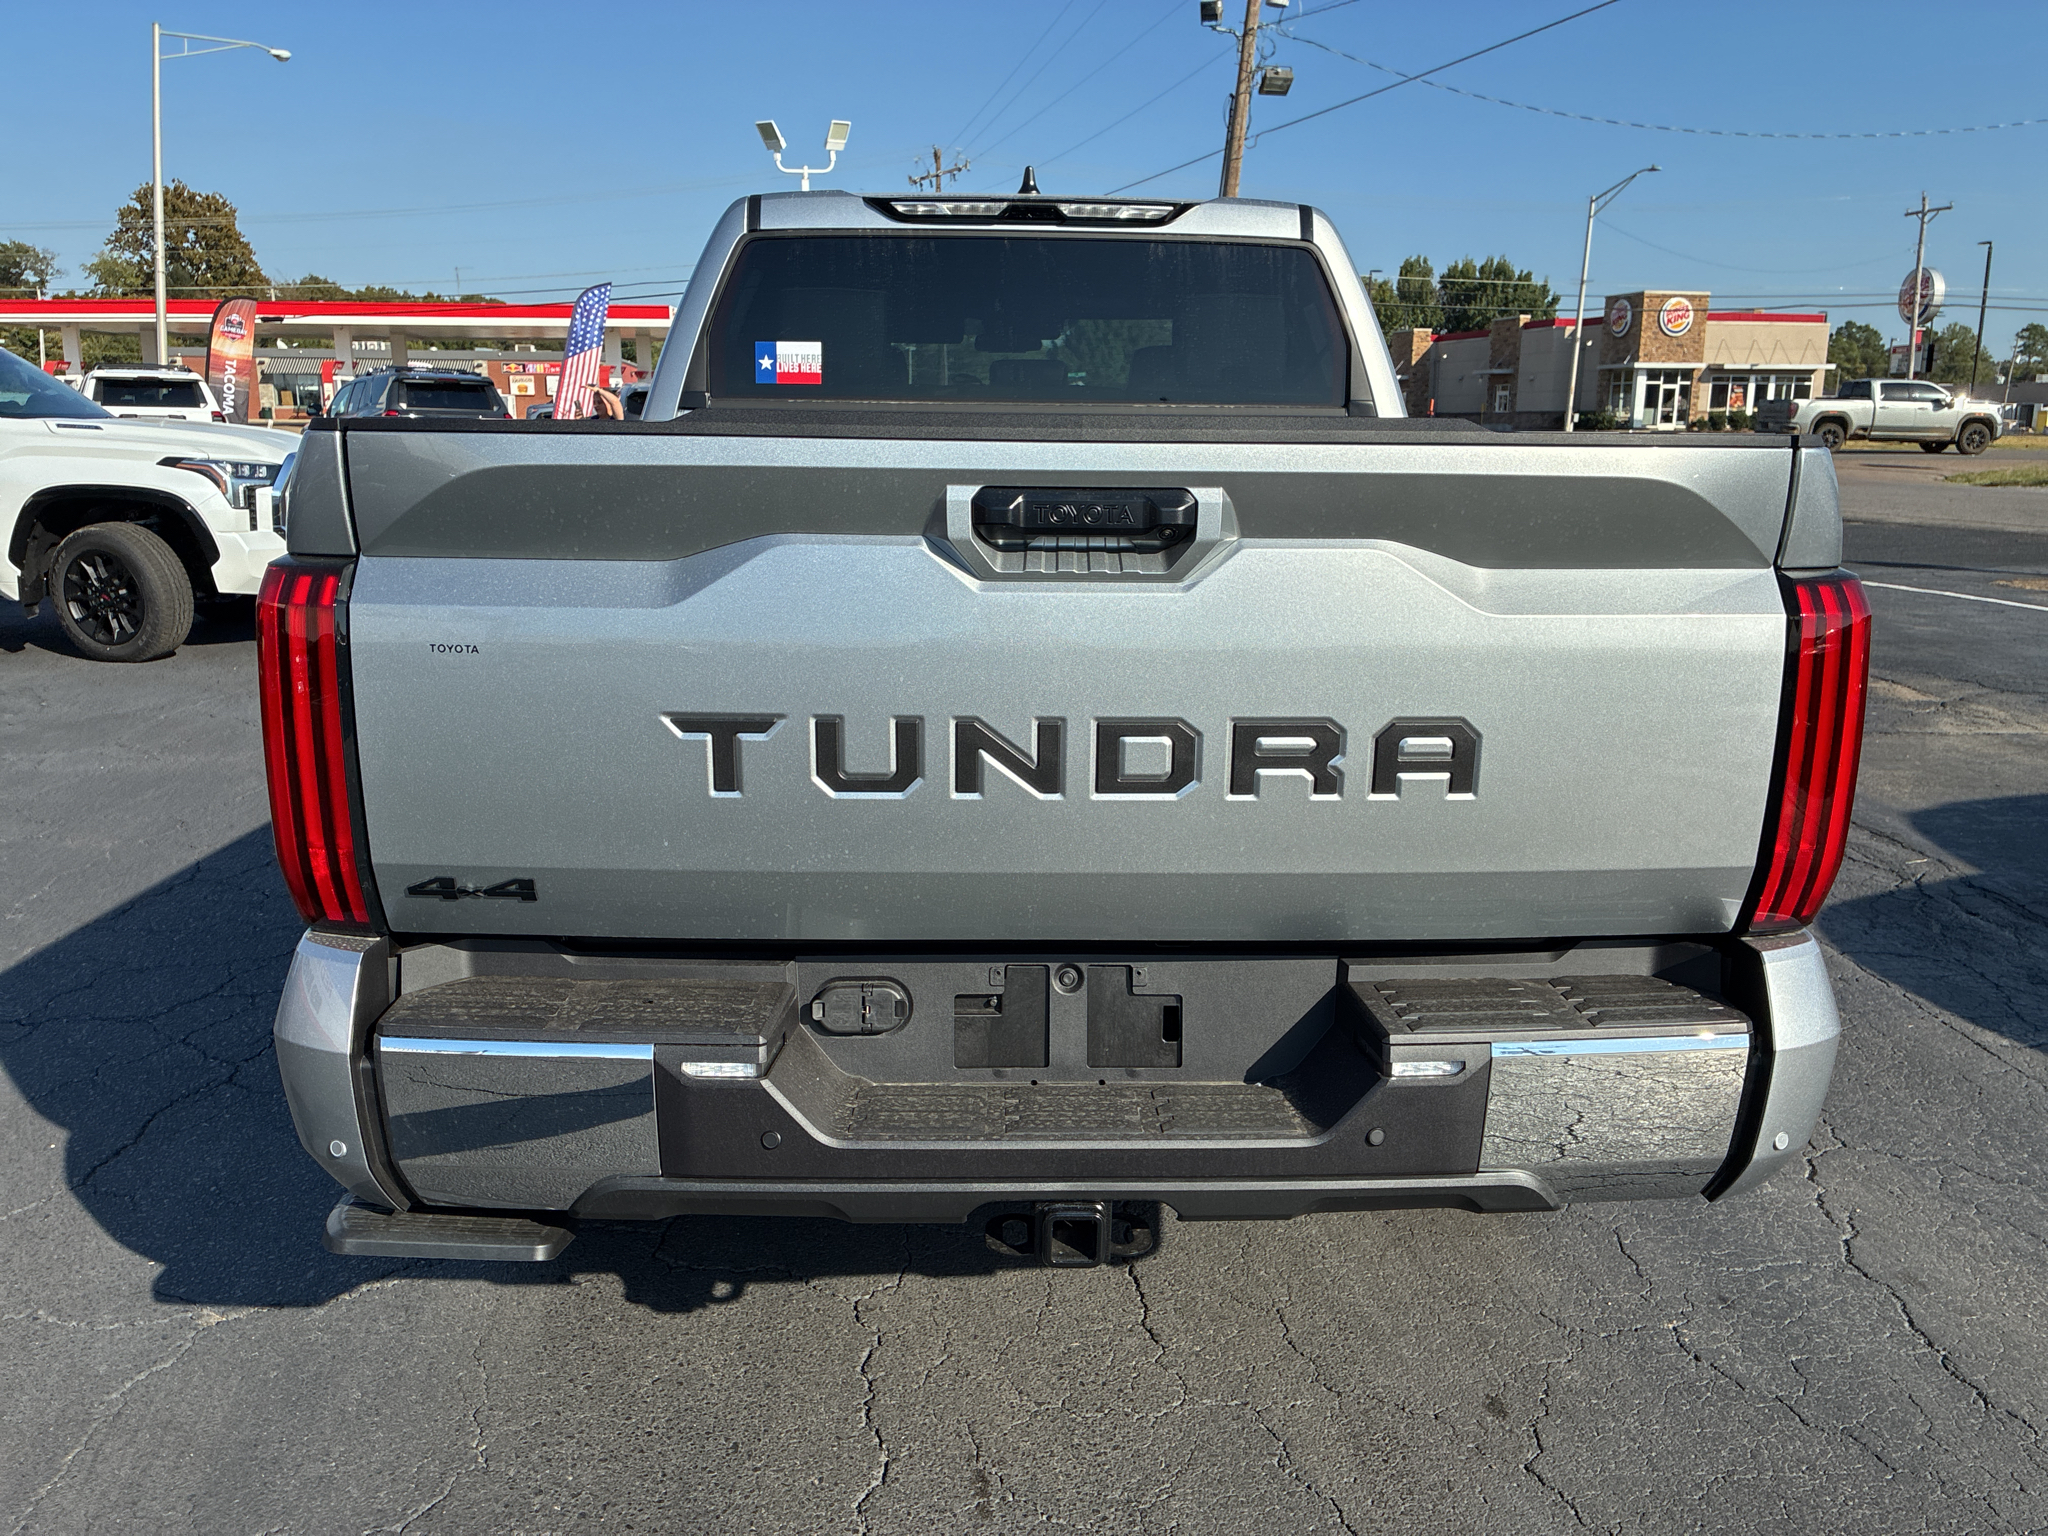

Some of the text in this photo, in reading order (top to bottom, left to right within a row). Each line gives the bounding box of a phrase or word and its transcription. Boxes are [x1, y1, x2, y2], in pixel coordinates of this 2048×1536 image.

[1666, 312, 1689, 327] KING
[777, 354, 822, 364] BUILT HERE
[777, 363, 822, 373] LIVES HERE
[223, 360, 237, 415] TACOMA
[1033, 504, 1135, 525] TOYOTA
[429, 643, 479, 654] TOYOTA
[659, 714, 1483, 801] TUNDRA
